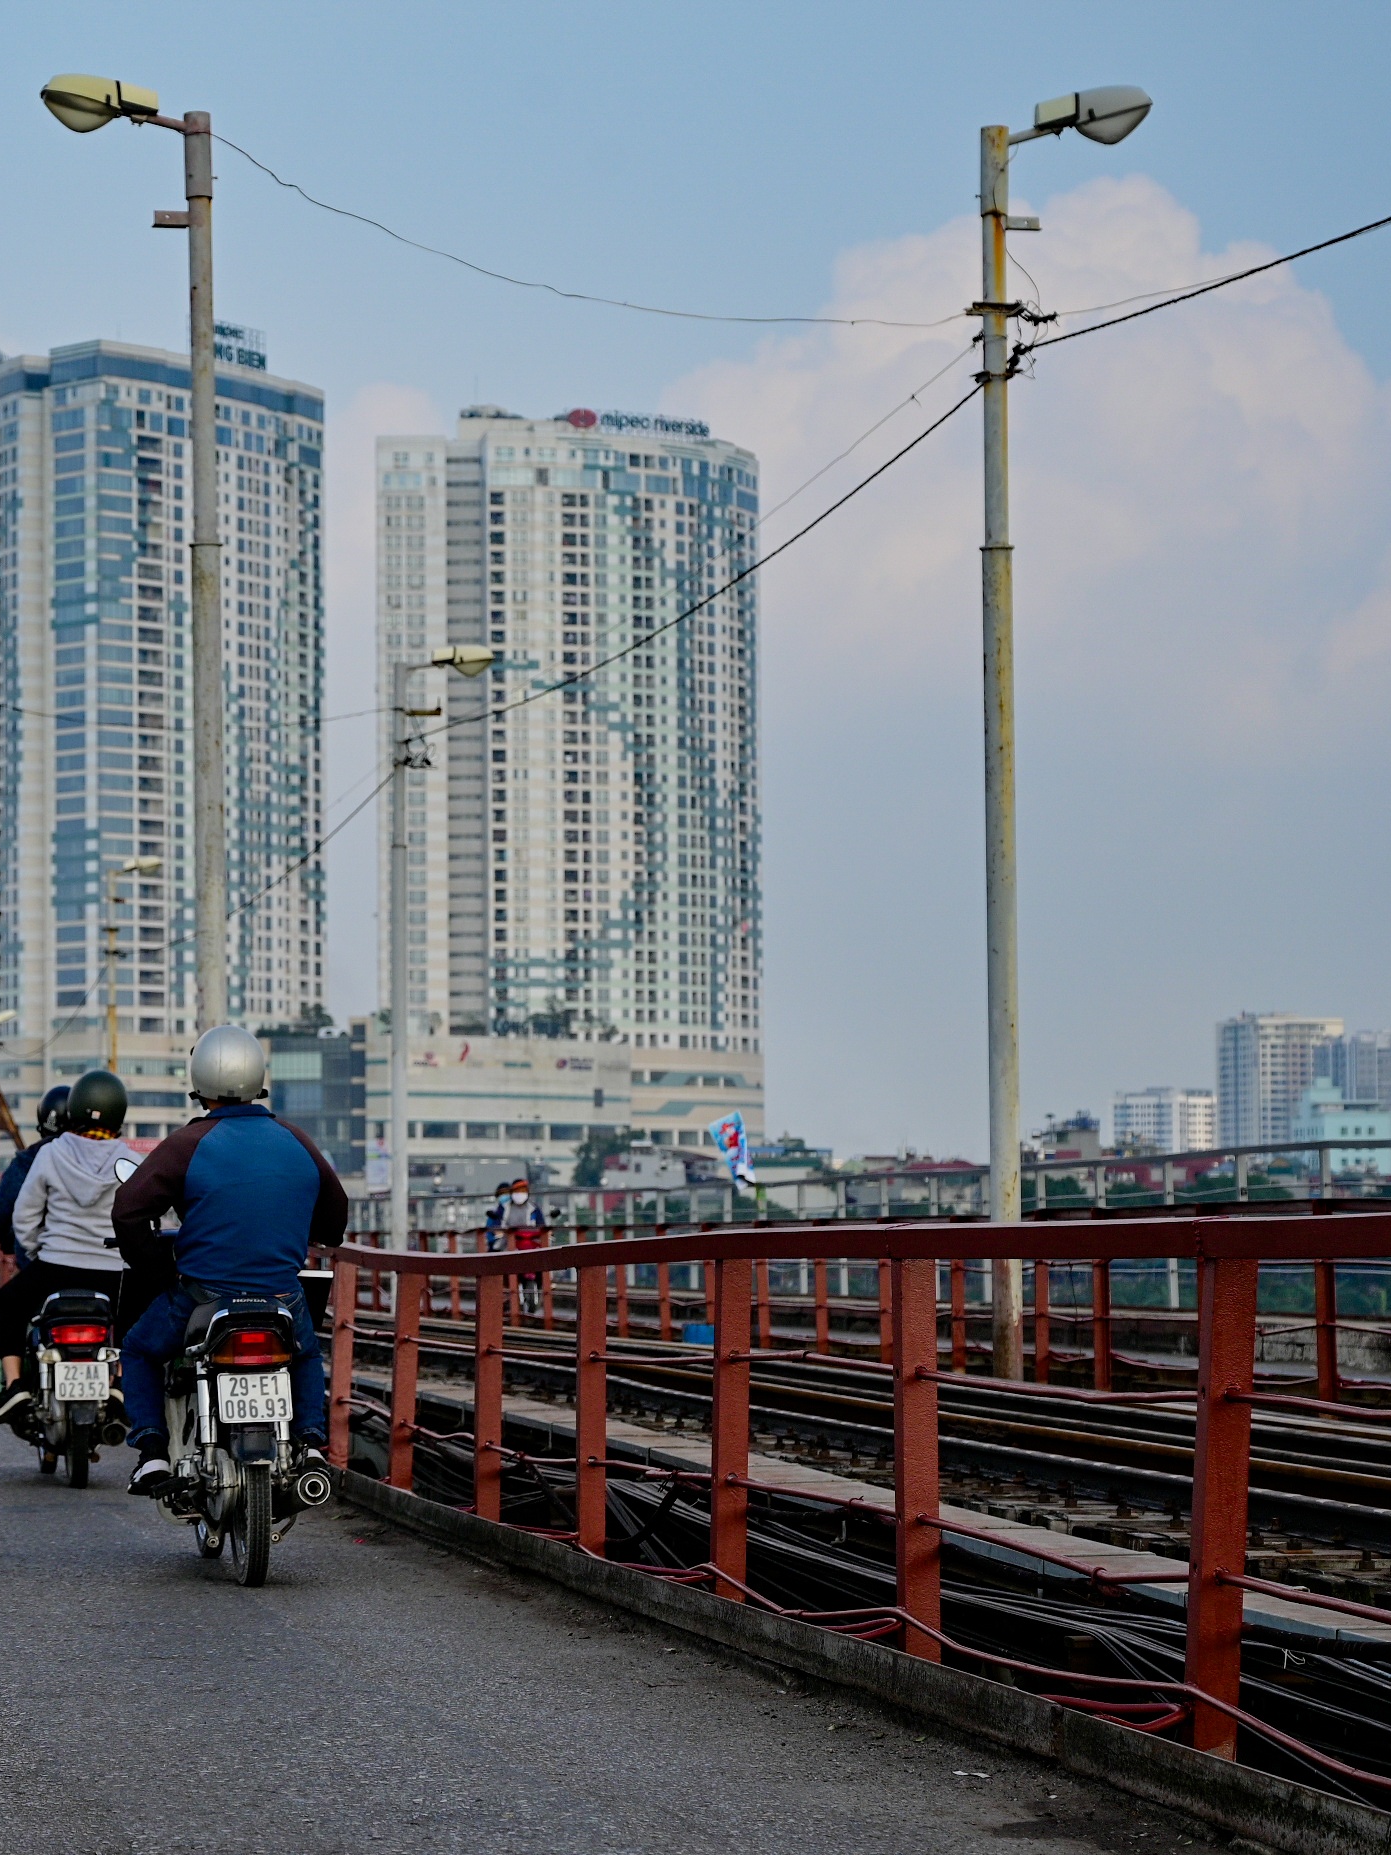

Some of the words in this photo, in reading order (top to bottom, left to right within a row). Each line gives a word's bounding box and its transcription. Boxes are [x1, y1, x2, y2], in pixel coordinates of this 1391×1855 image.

[600, 410, 650, 430] mipec
[654, 414, 710, 437] riverside
[64, 1366, 100, 1381] 22-AA
[58, 1382, 106, 1398] 023.52
[229, 1376, 280, 1397] 29-E1
[225, 1398, 288, 1420] 086.93
